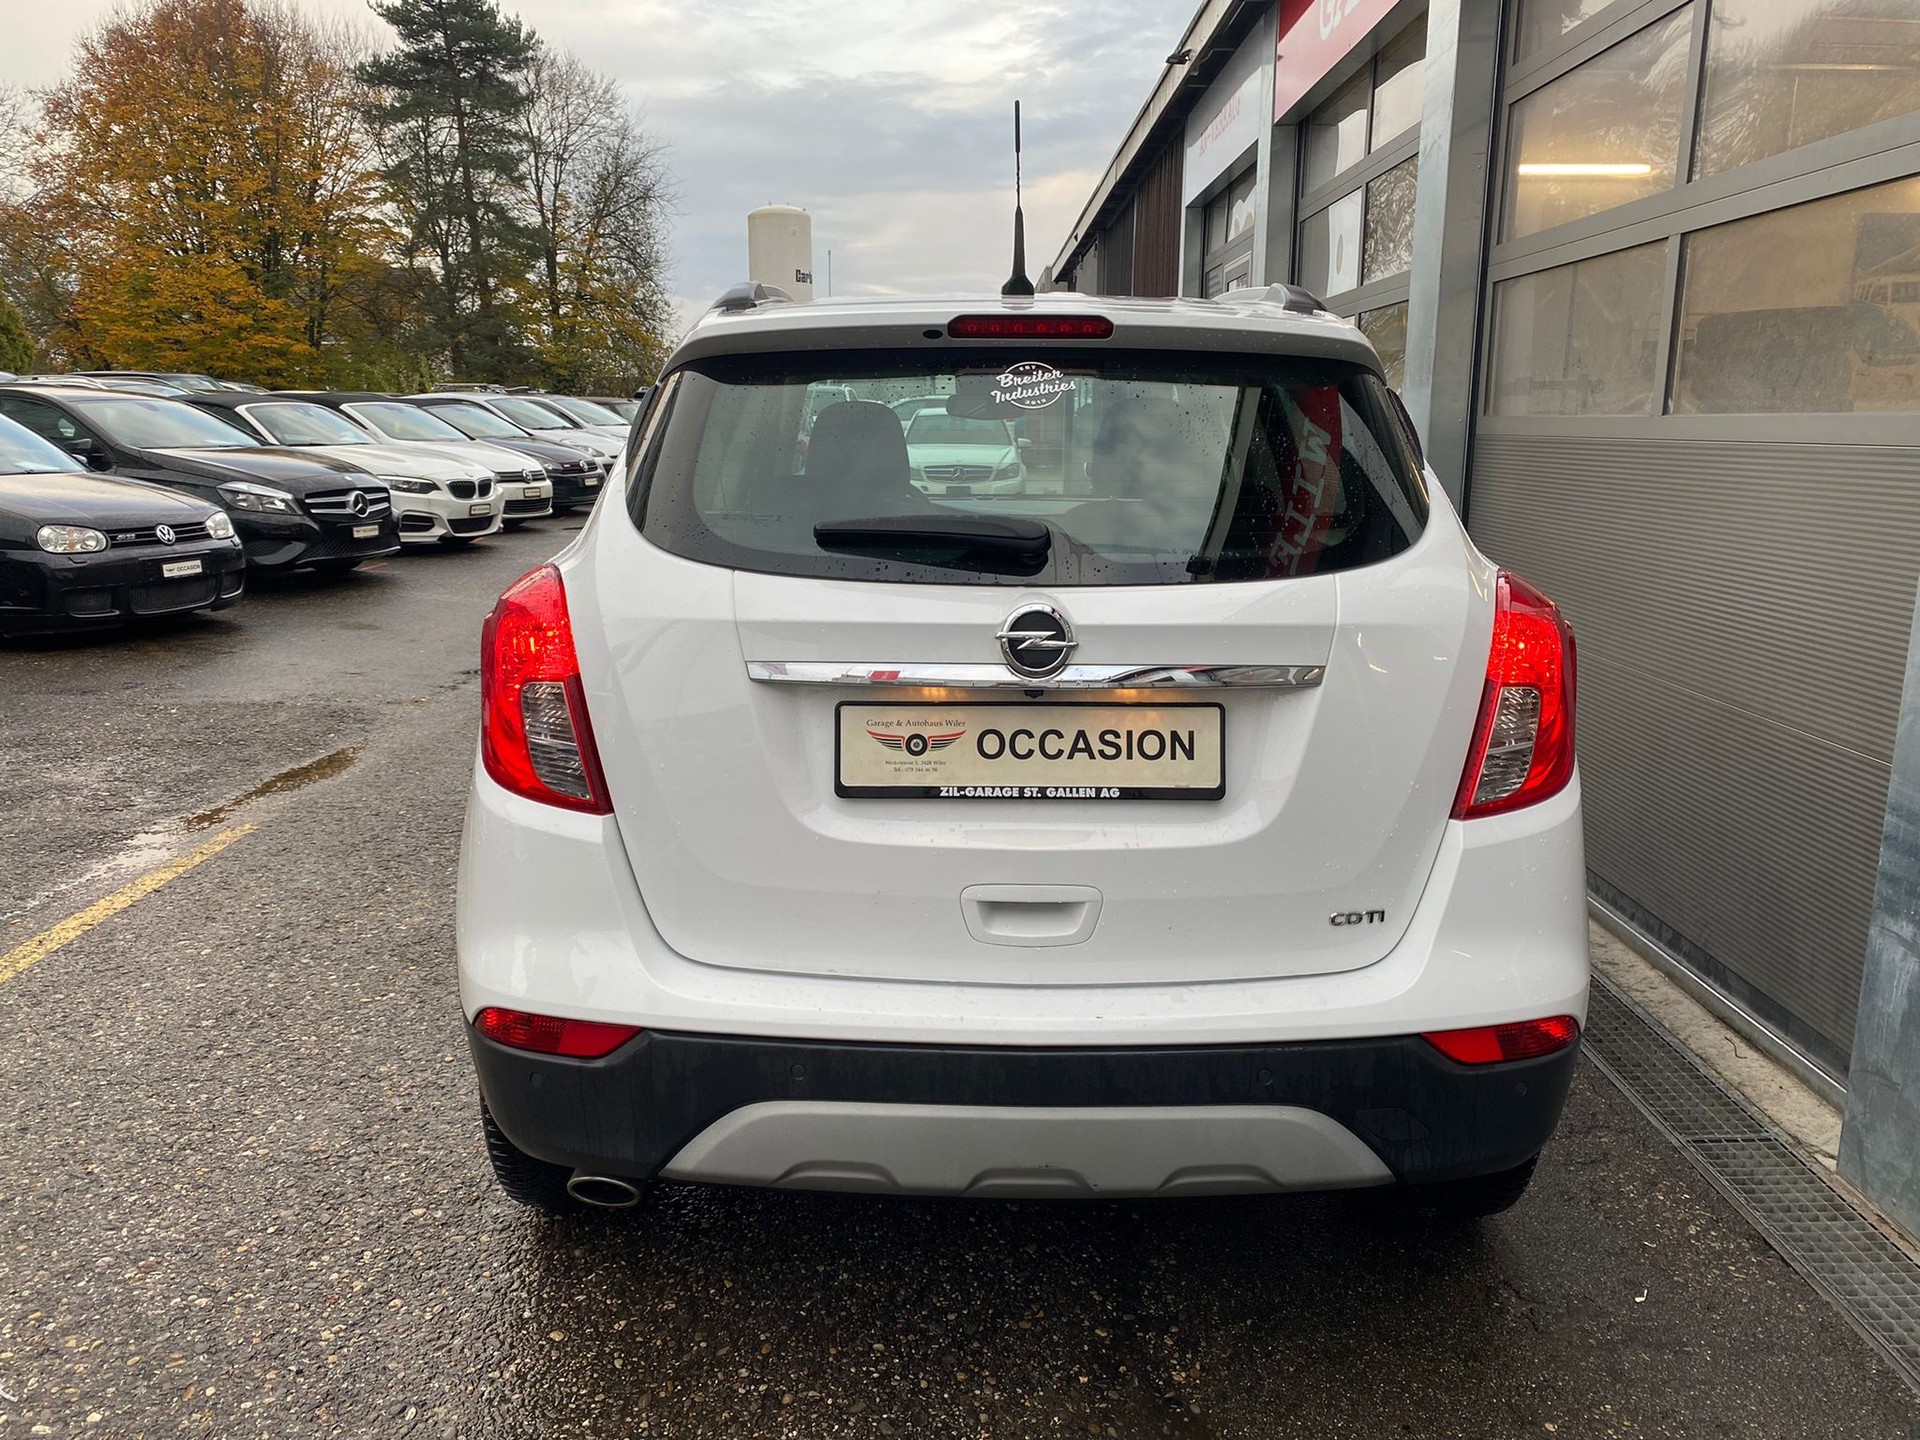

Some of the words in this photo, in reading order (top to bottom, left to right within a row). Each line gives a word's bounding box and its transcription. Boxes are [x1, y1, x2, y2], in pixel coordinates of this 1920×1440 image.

[996, 369, 1063, 388] Breiter
[990, 381, 1076, 404] Industries
[176, 564, 200, 573] OCCASION
[866, 719, 894, 729] Garage
[896, 719, 903, 727] &
[905, 719, 943, 728] Autohaus
[945, 719, 966, 728] Wiler
[976, 728, 1195, 761] OCCASION
[939, 787, 1020, 797] ZIL-GARAGE
[1023, 787, 1042, 797] ST.
[1046, 787, 1096, 798] GALLEN
[1100, 787, 1120, 798] AG
